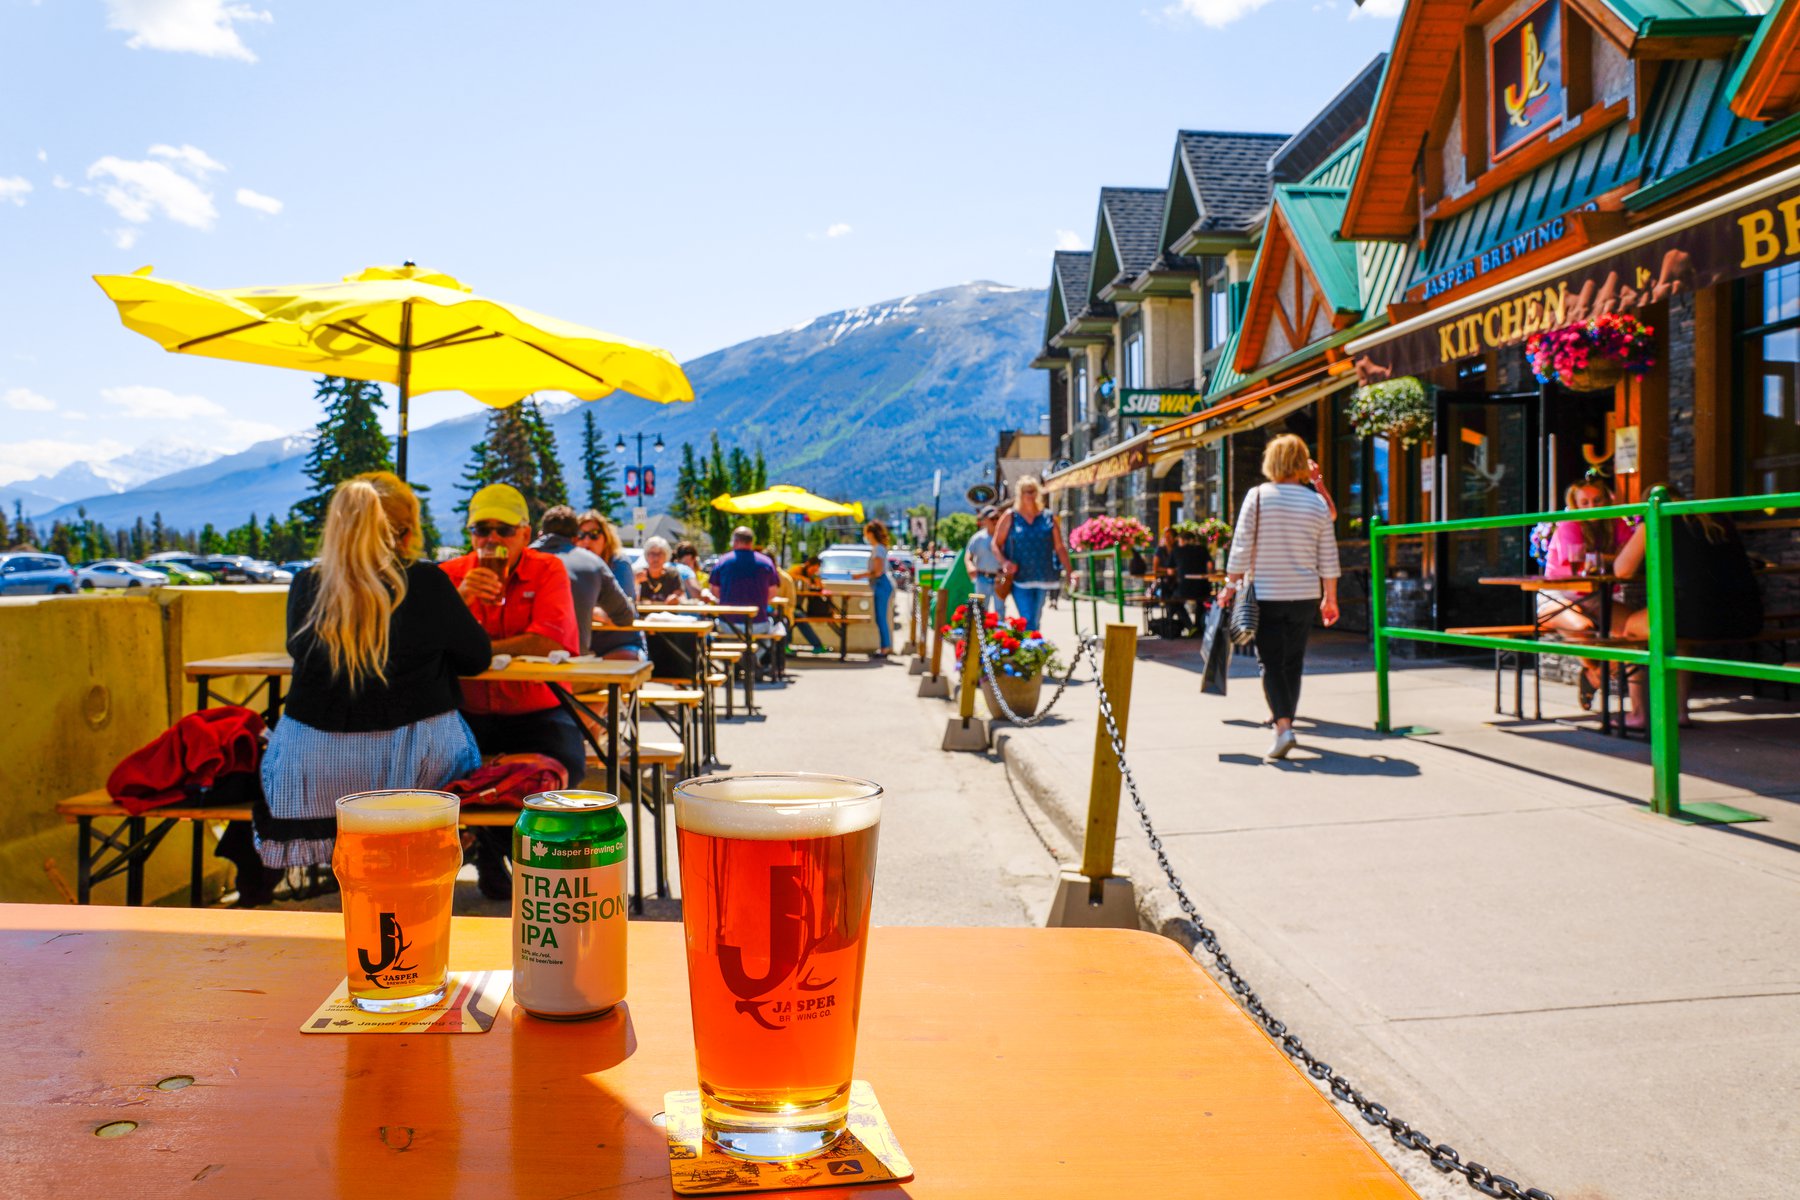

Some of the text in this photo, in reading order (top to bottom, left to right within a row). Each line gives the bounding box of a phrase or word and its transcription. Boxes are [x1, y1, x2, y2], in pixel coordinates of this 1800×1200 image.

[1422, 216, 1566, 300] JASPER BREWING
[1437, 281, 1568, 363] KITCHEN
[1122, 393, 1202, 413] SUBWAY
[551, 847, 581, 857] Jasper
[583, 844, 615, 856] Brewing
[521, 872, 598, 899] TRAIL
[521, 893, 625, 924] SESSION
[521, 922, 559, 949] IPA
[382, 972, 419, 982] JASPER
[772, 994, 836, 1014] JASPER
